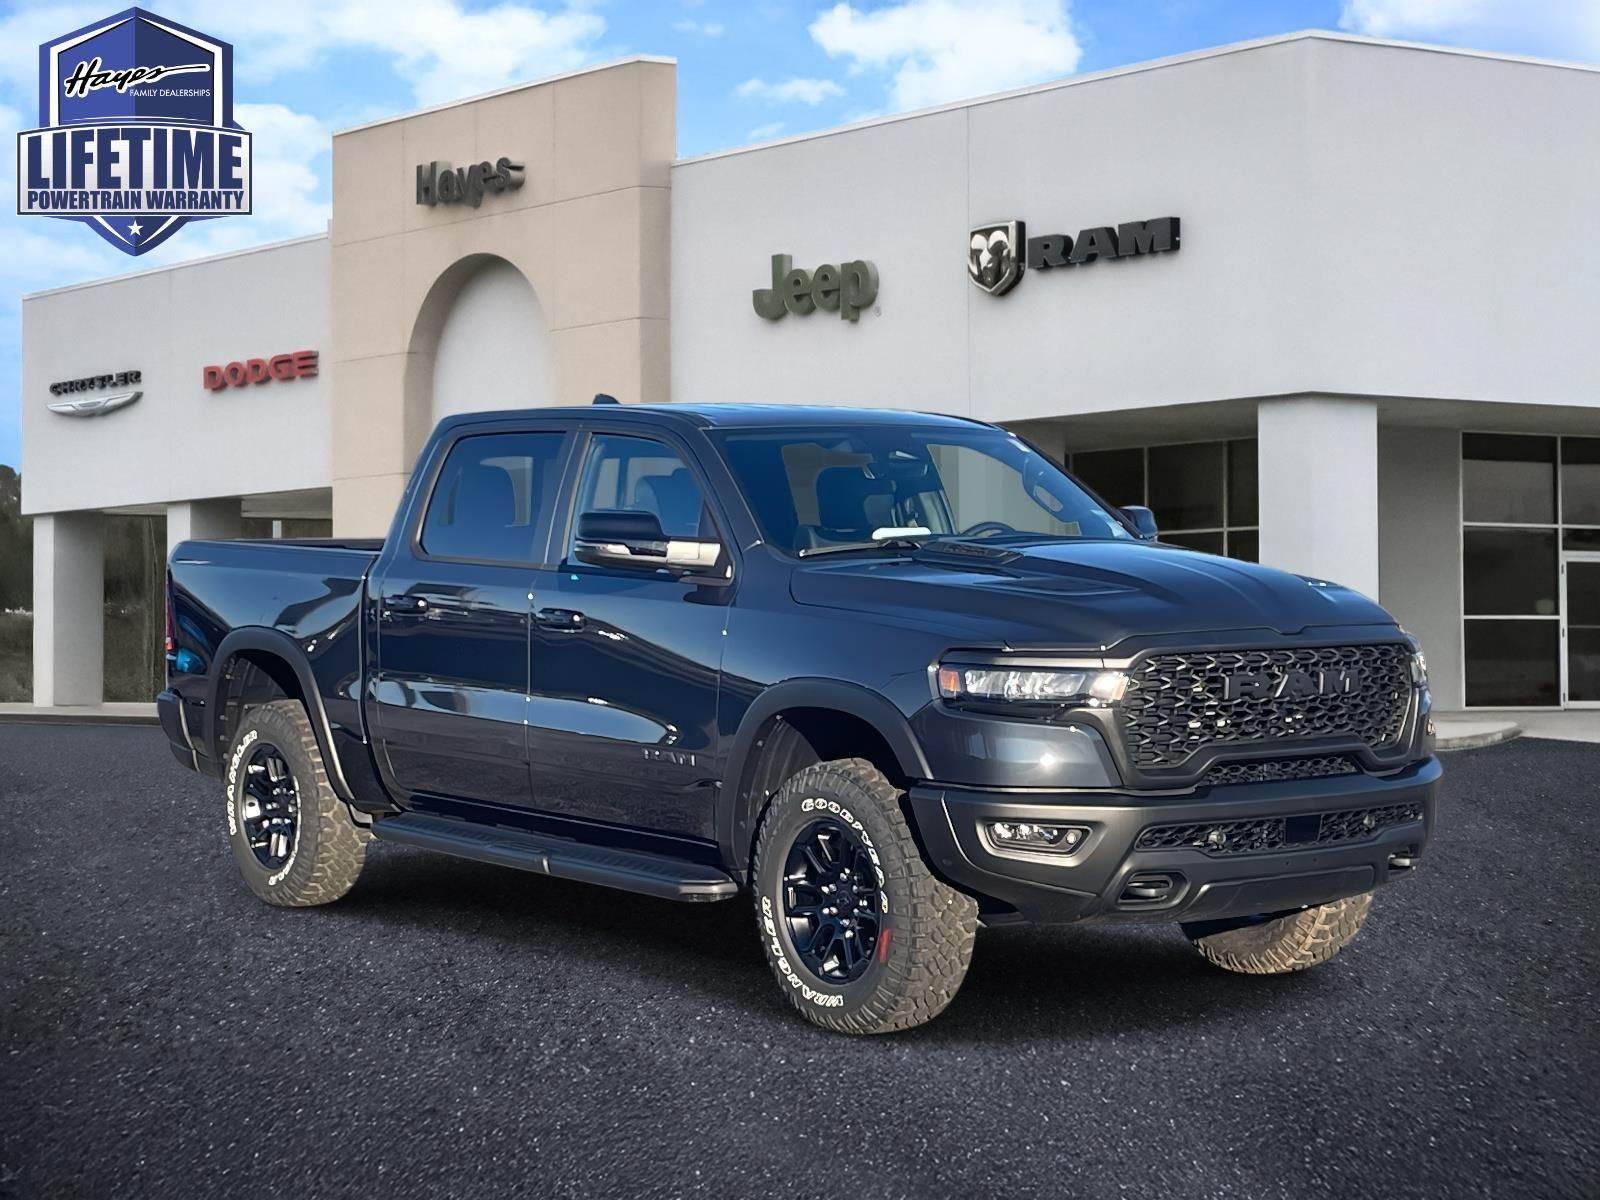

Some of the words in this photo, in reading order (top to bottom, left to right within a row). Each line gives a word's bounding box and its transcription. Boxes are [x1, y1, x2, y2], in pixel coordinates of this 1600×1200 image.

[416, 157, 525, 209] Hayes
[1027, 216, 1181, 270] RAM
[752, 253, 879, 322] Jeep
[49, 370, 142, 396] CHRYSLER
[203, 350, 319, 392] DODGE
[1224, 669, 1360, 700] RAM
[801, 798, 889, 914] GOODYEAR
[762, 896, 844, 1007] WRANGLER
